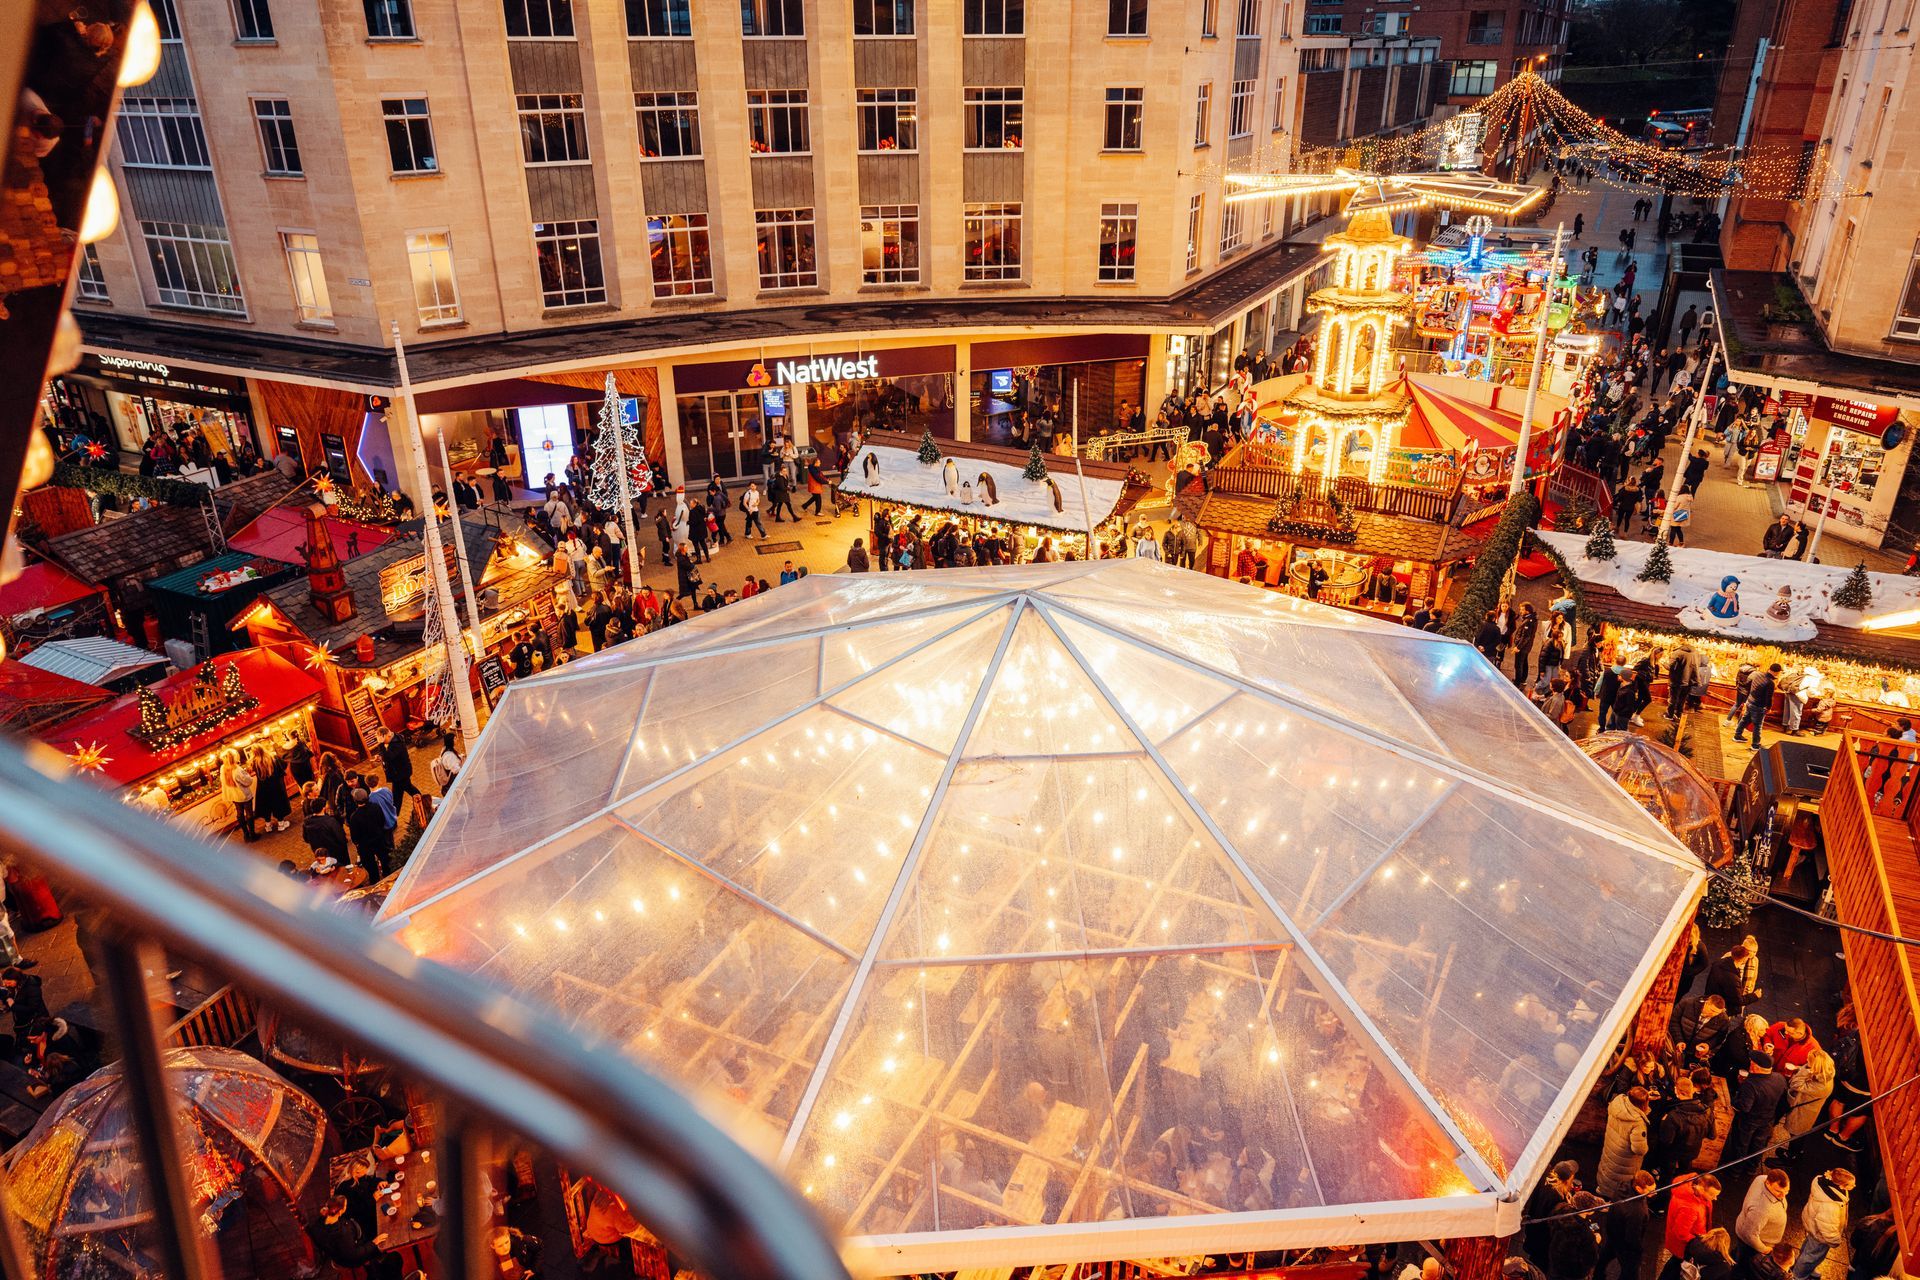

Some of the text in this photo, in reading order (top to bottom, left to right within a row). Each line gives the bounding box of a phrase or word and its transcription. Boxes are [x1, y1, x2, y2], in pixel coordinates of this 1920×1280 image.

[98, 354, 170, 377] Superdrug
[776, 355, 879, 385] NatWest
[1830, 402, 1877, 420] SHOE REPAIRS
[1849, 399, 1877, 411] CUTTING
[1833, 412, 1870, 427] ENGRAVING
